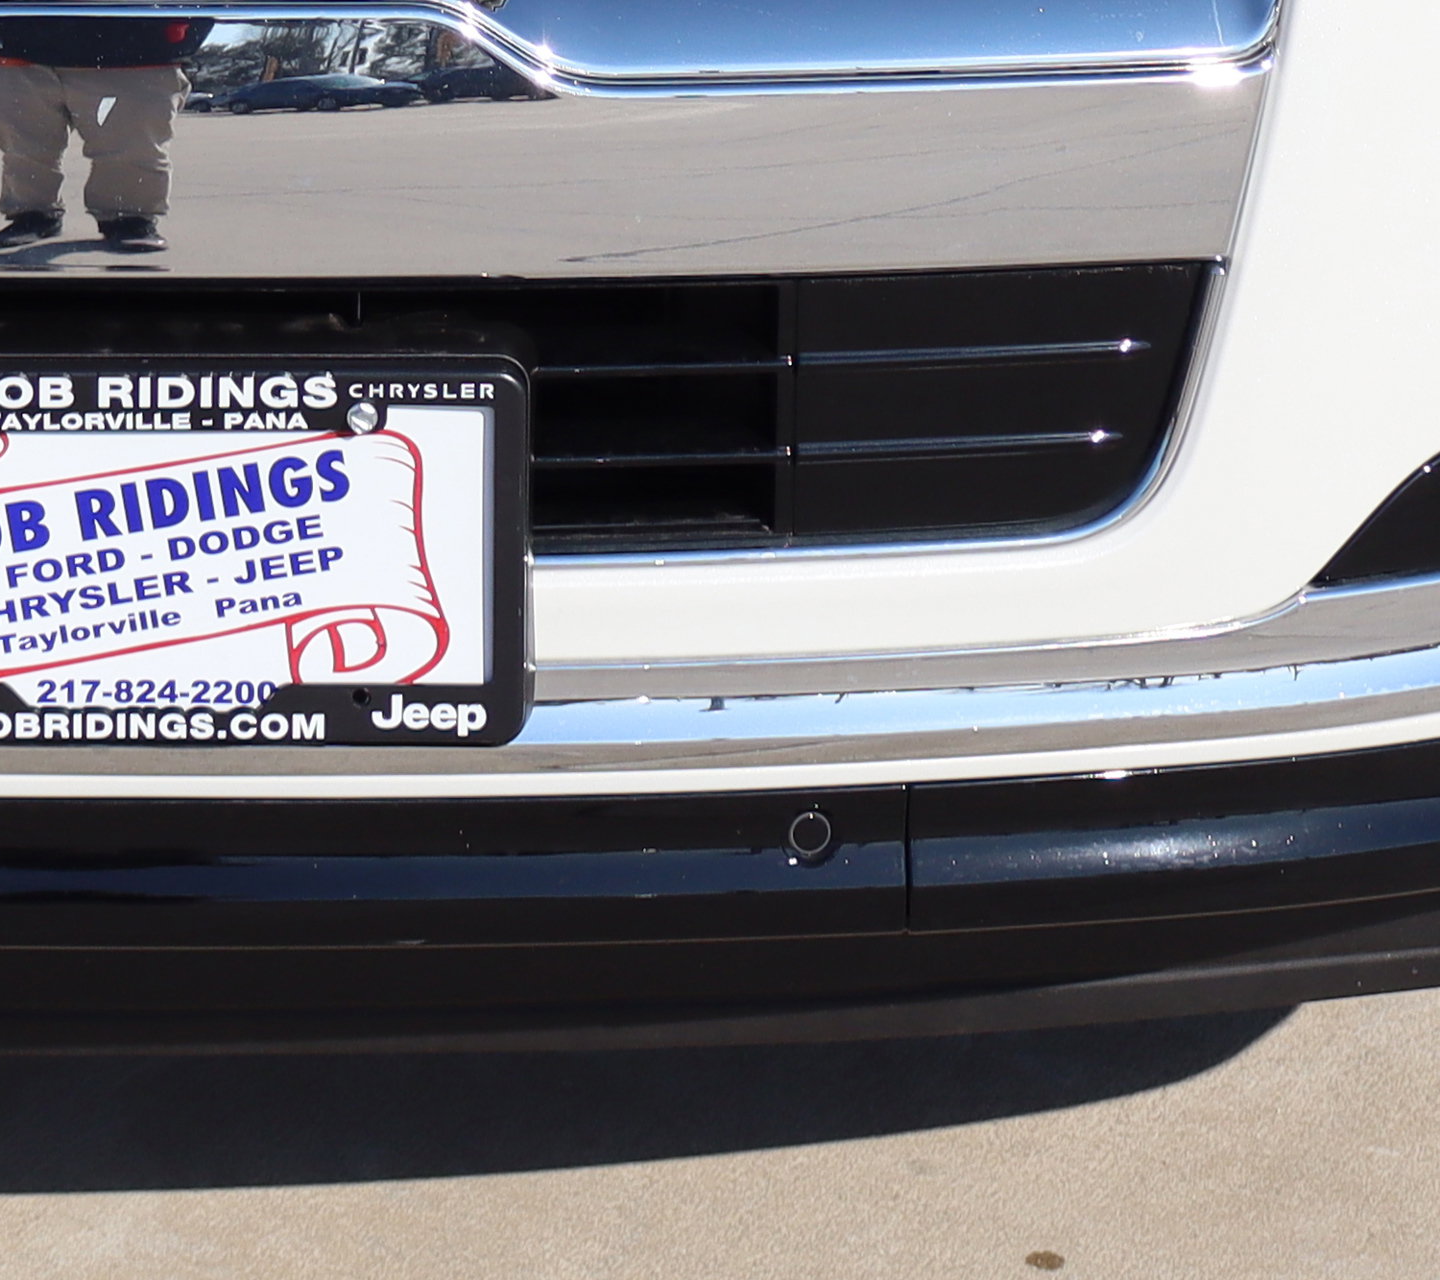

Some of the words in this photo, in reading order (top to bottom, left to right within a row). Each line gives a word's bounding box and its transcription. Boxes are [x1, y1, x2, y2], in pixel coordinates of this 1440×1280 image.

[97, 374, 338, 410] RIDINGS
[348, 383, 495, 400] CHRYSLER
[224, 411, 308, 430] PANA
[74, 450, 350, 541] RIDINGS
[6, 547, 126, 589] FORD
[167, 515, 324, 561] DODGE
[233, 546, 344, 585] JEEP
[215, 591, 303, 619] Pana
[36, 679, 278, 705] 217-824-2200
[371, 694, 488, 737] Jeep
